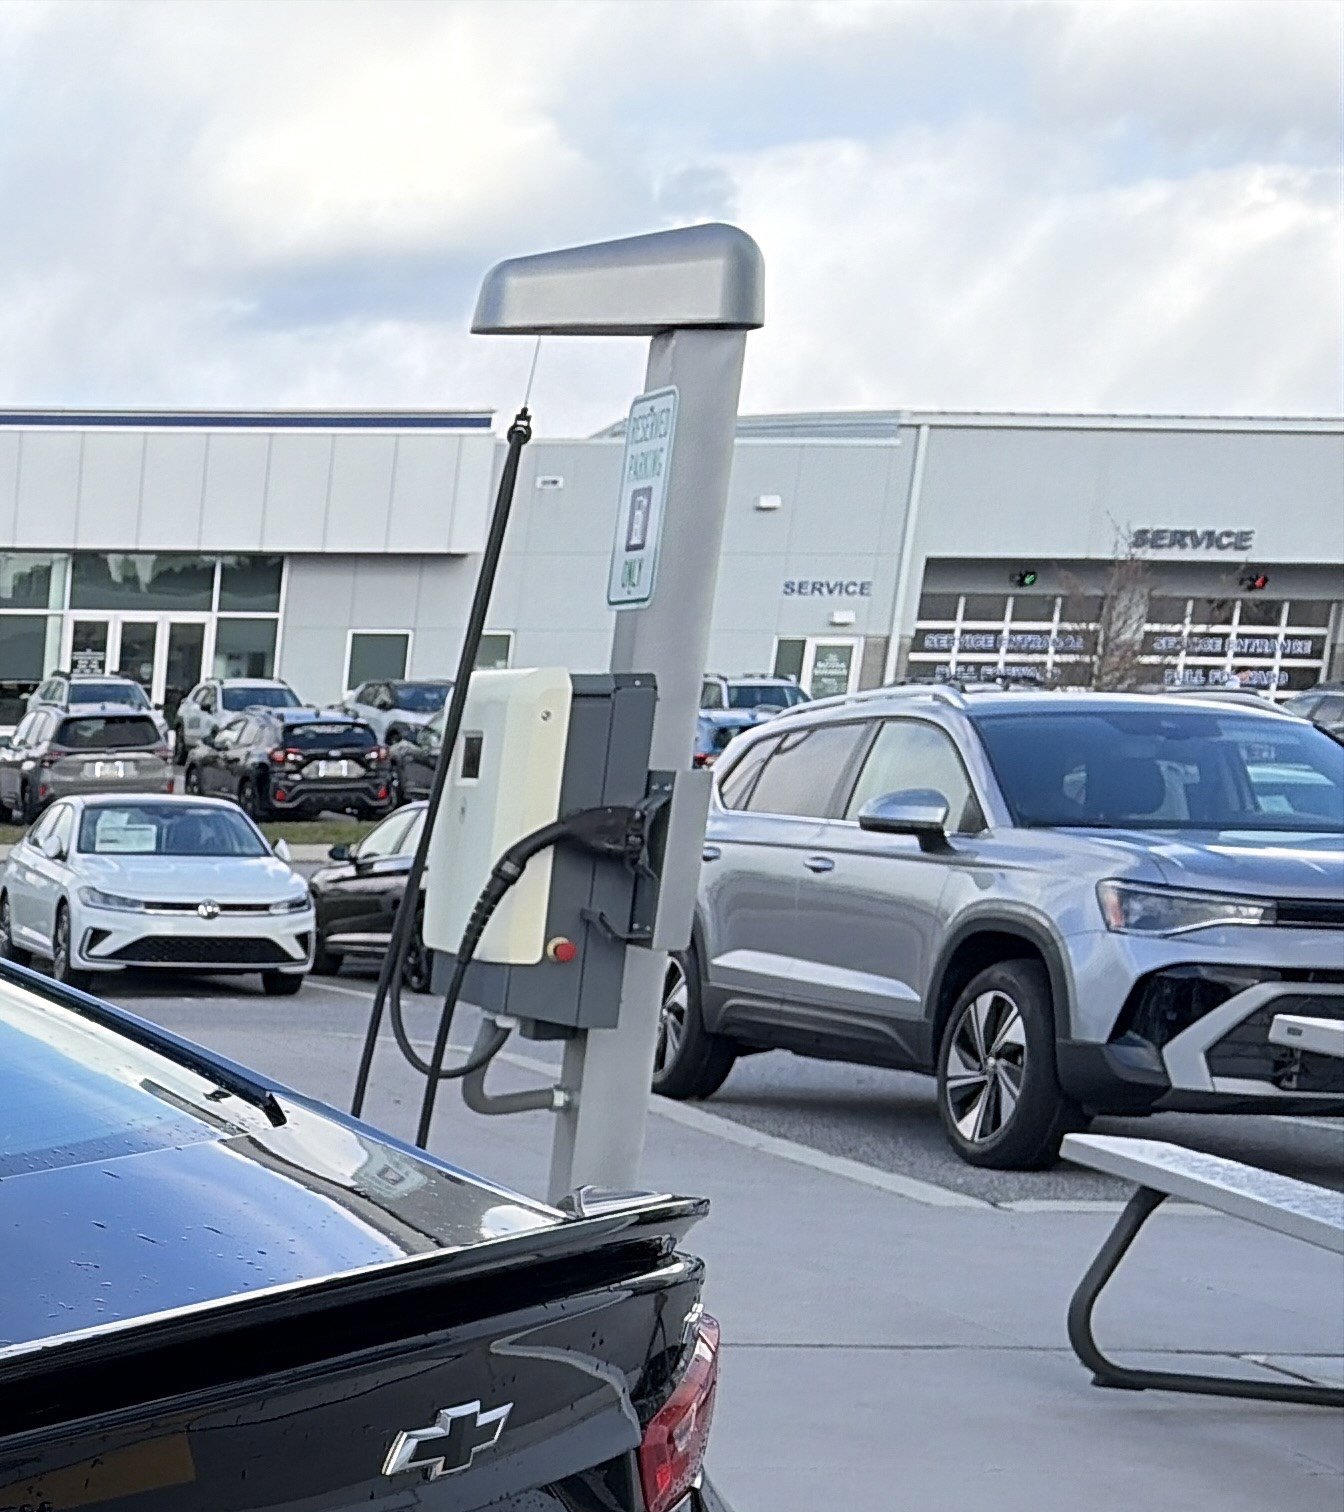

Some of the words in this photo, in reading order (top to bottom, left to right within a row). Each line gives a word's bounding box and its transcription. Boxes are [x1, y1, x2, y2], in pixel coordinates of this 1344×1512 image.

[627, 447, 663, 481] PARKING
[1131, 528, 1255, 551] SERVICE
[620, 557, 643, 588] ONLY
[783, 580, 873, 597] SERVICE
